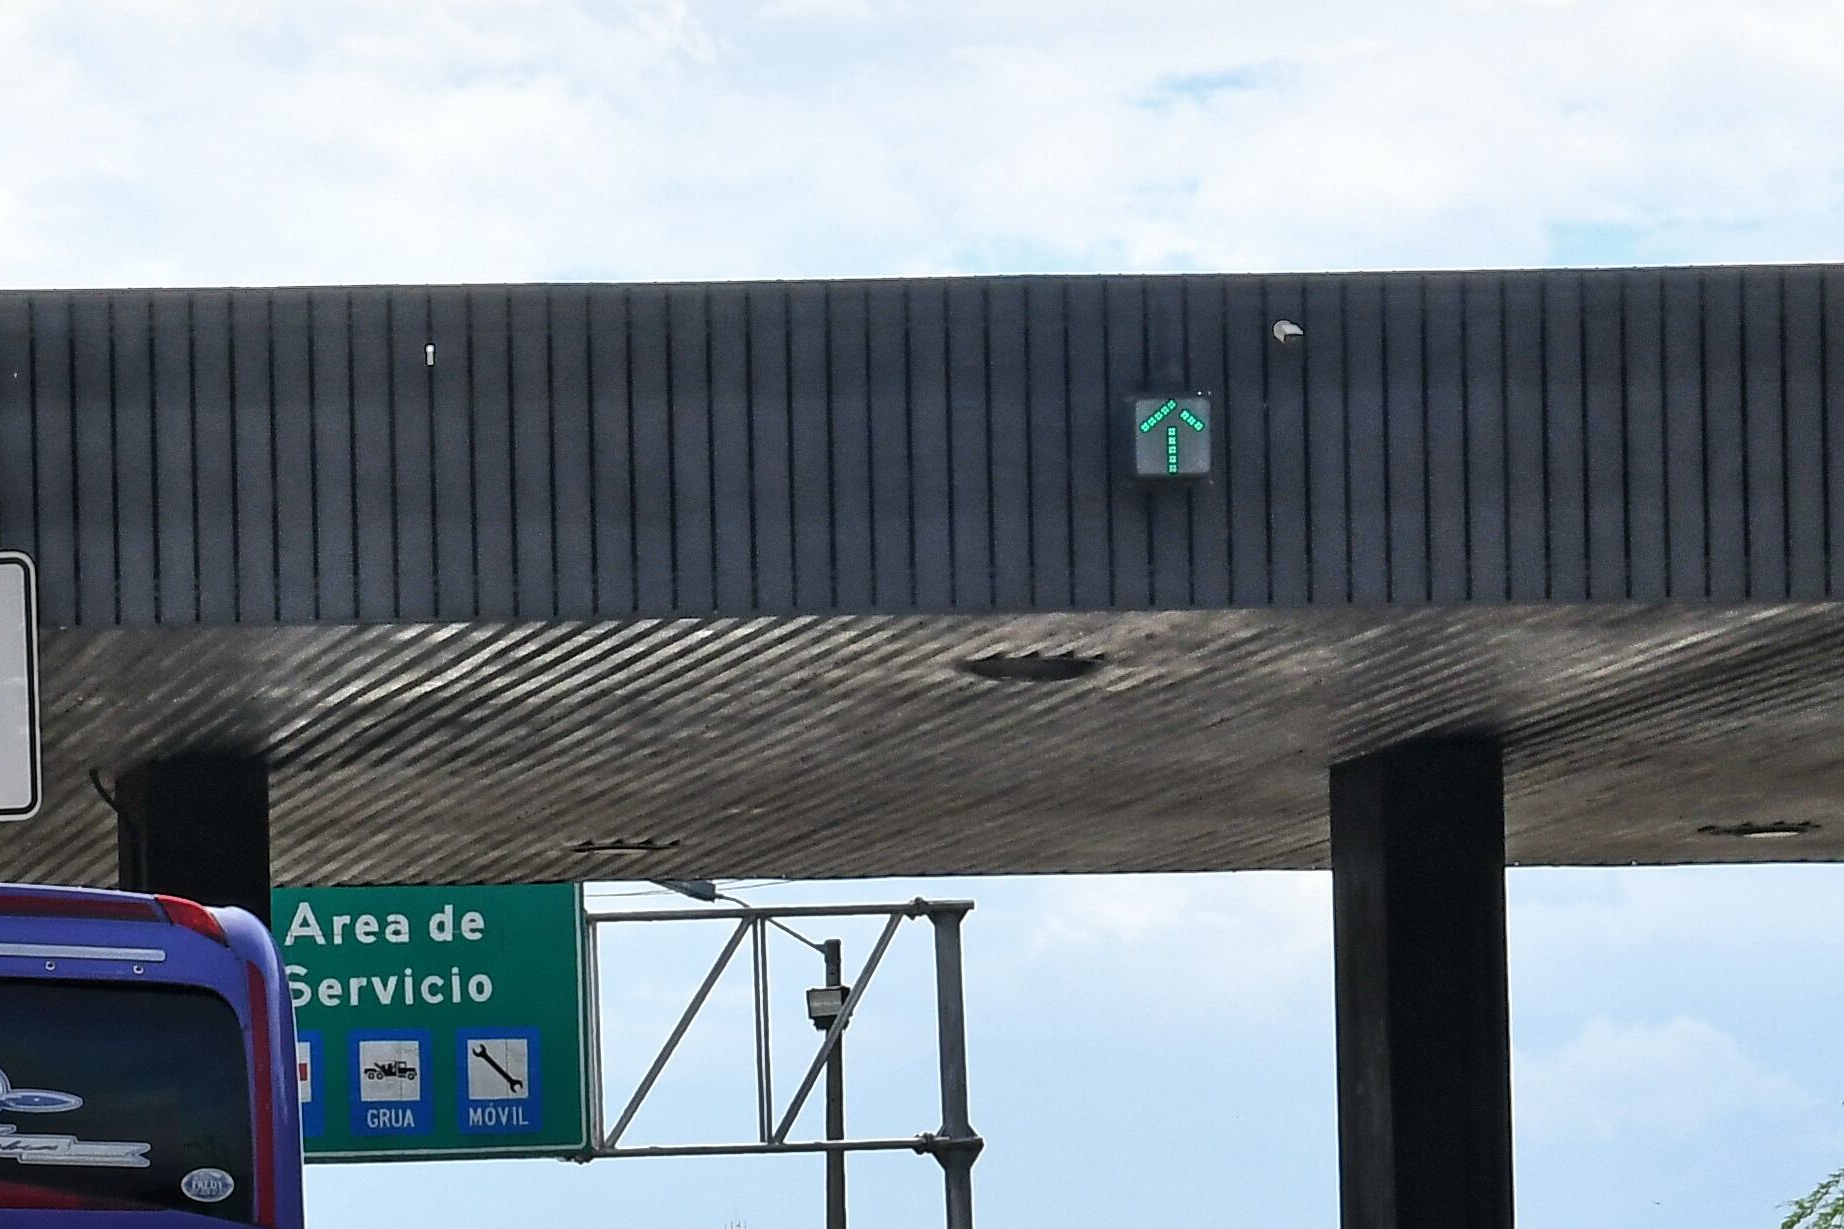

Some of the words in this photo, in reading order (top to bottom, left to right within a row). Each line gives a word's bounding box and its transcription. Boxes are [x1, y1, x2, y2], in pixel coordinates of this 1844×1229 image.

[284, 902, 410, 946] Area
[428, 904, 485, 942] de
[285, 964, 494, 1007] Servicio
[367, 1108, 415, 1128] GRUA
[468, 1102, 529, 1126] MÓVIL
